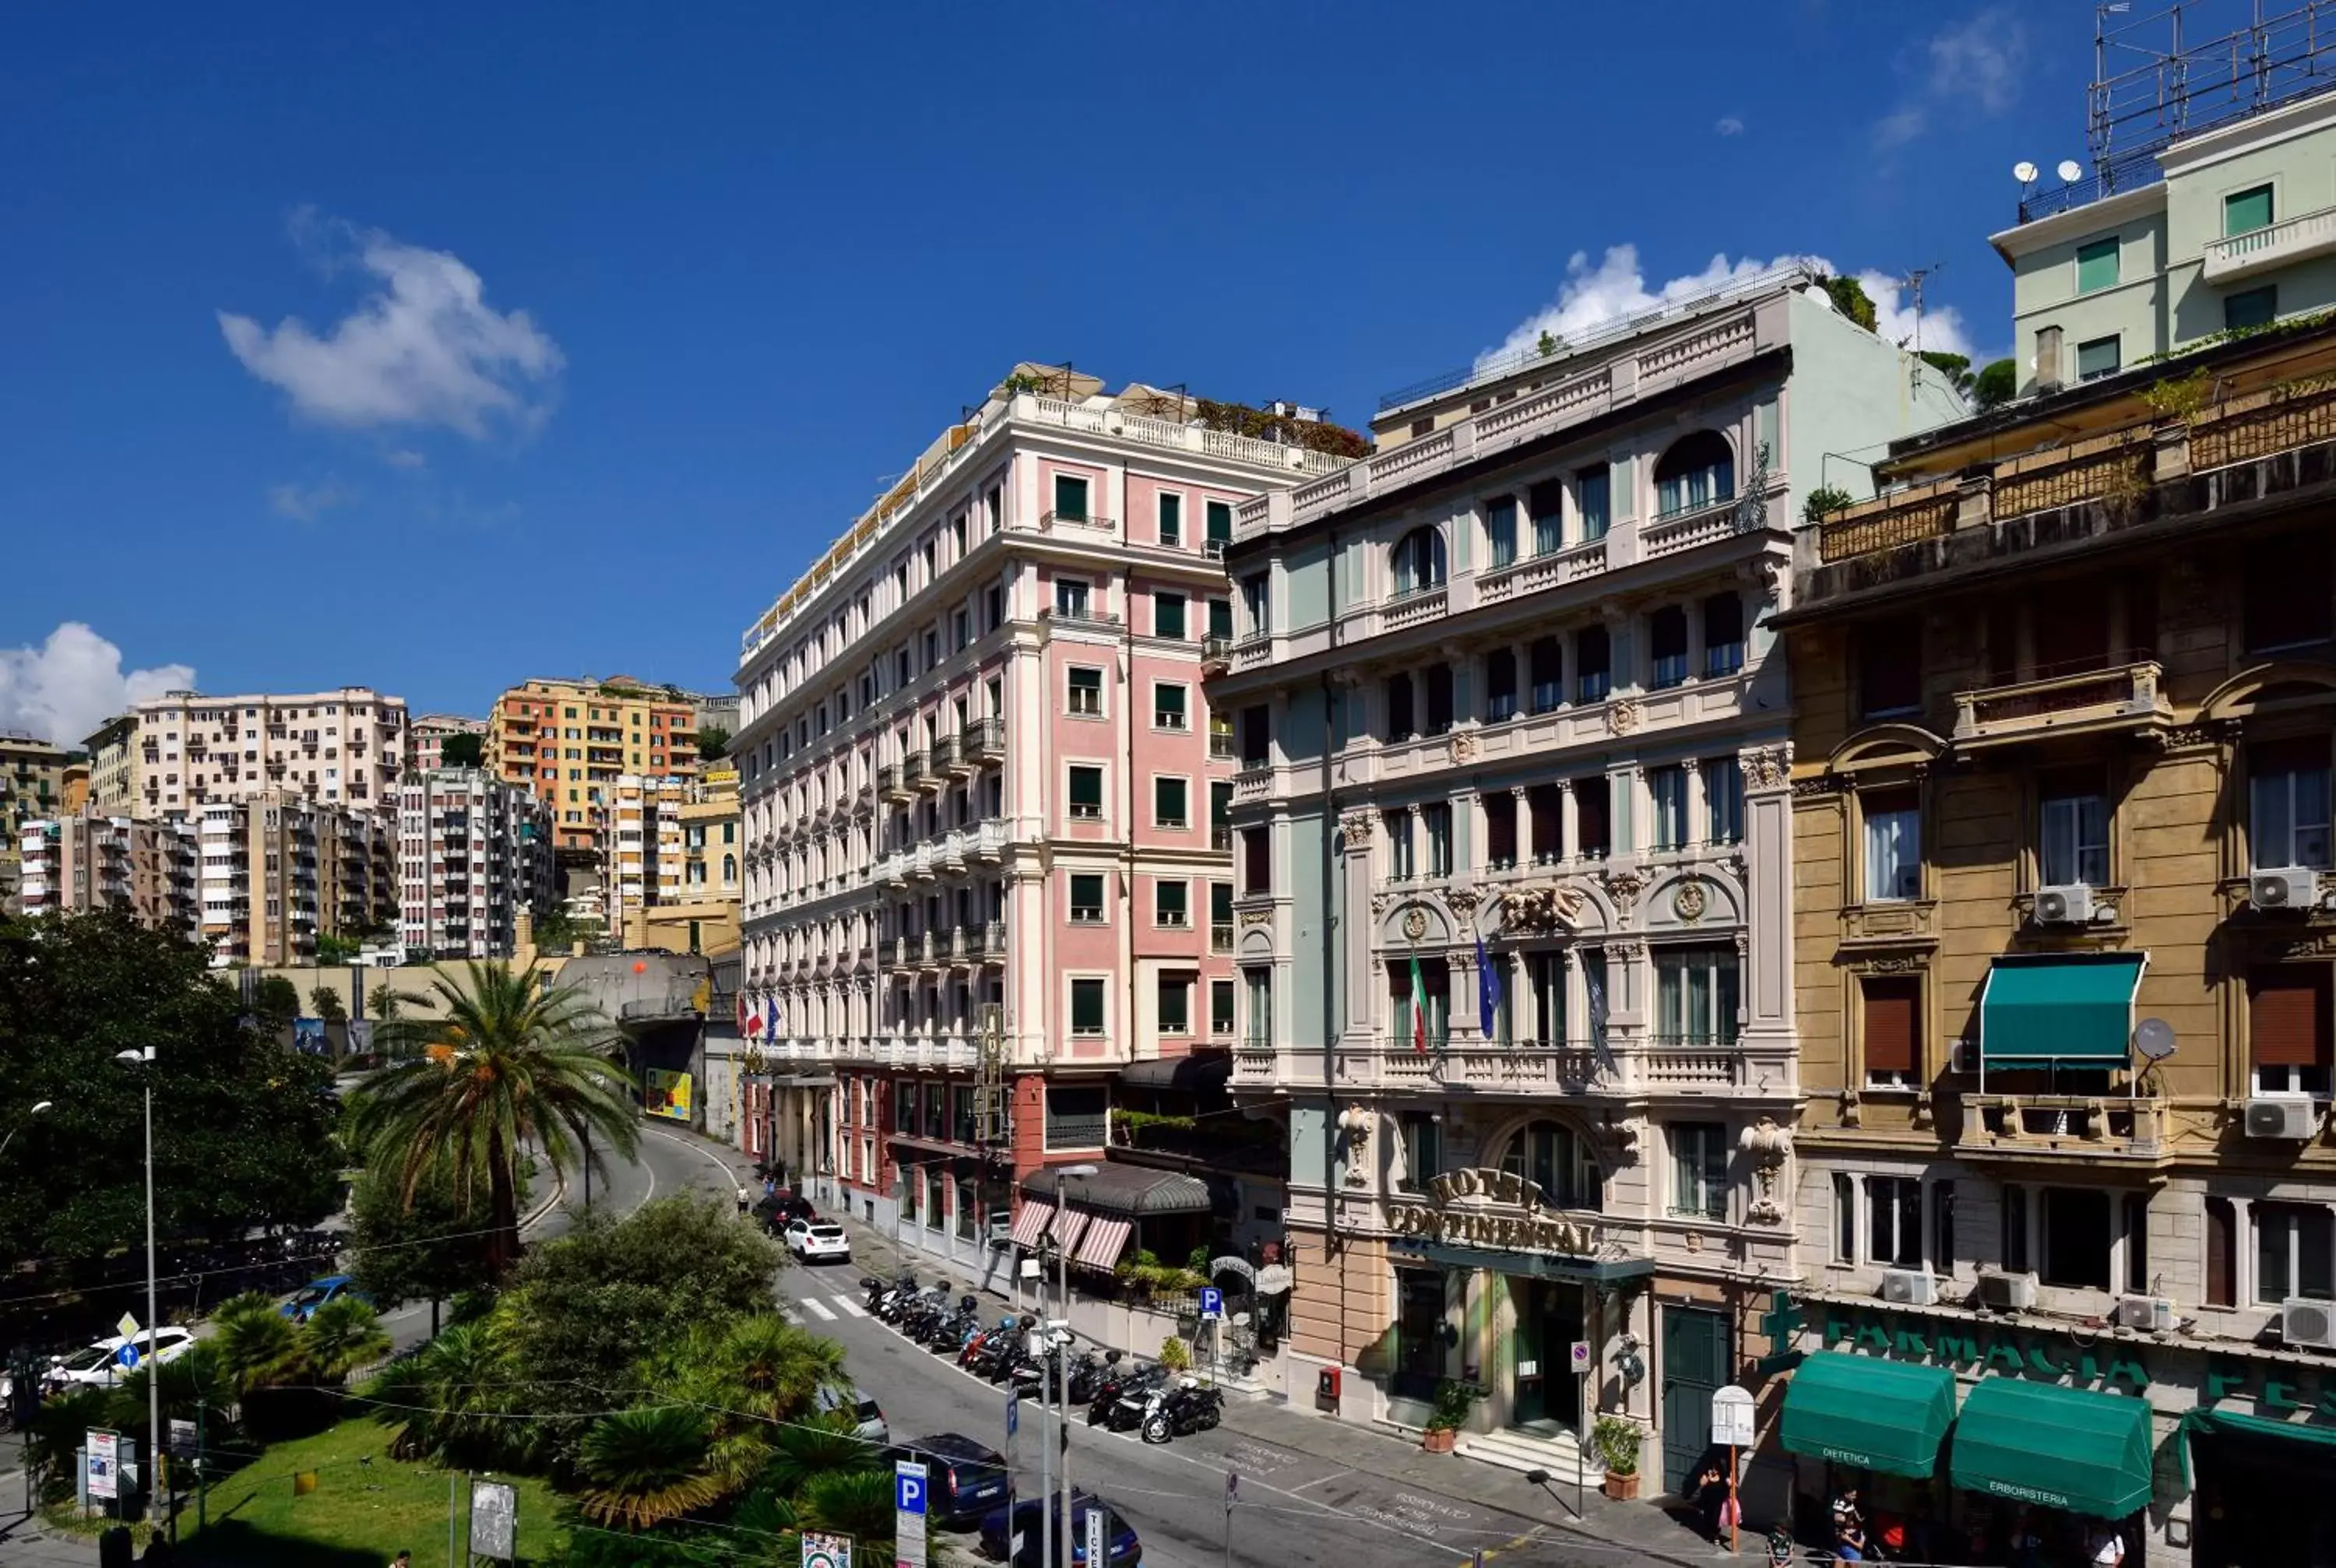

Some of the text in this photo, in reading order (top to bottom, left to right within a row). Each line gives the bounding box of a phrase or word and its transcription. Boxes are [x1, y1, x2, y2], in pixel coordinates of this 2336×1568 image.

[1429, 1167, 1543, 1217] HOTEL
[1385, 1204, 1599, 1254] CONTINENTAL
[1205, 1290, 1219, 1309] P
[1825, 1310, 2152, 1390] FARMACIA
[1822, 1447, 1870, 1465] DIETETICA
[902, 1478, 920, 1507] P
[1989, 1482, 2068, 1506] ERBORISTERIA
